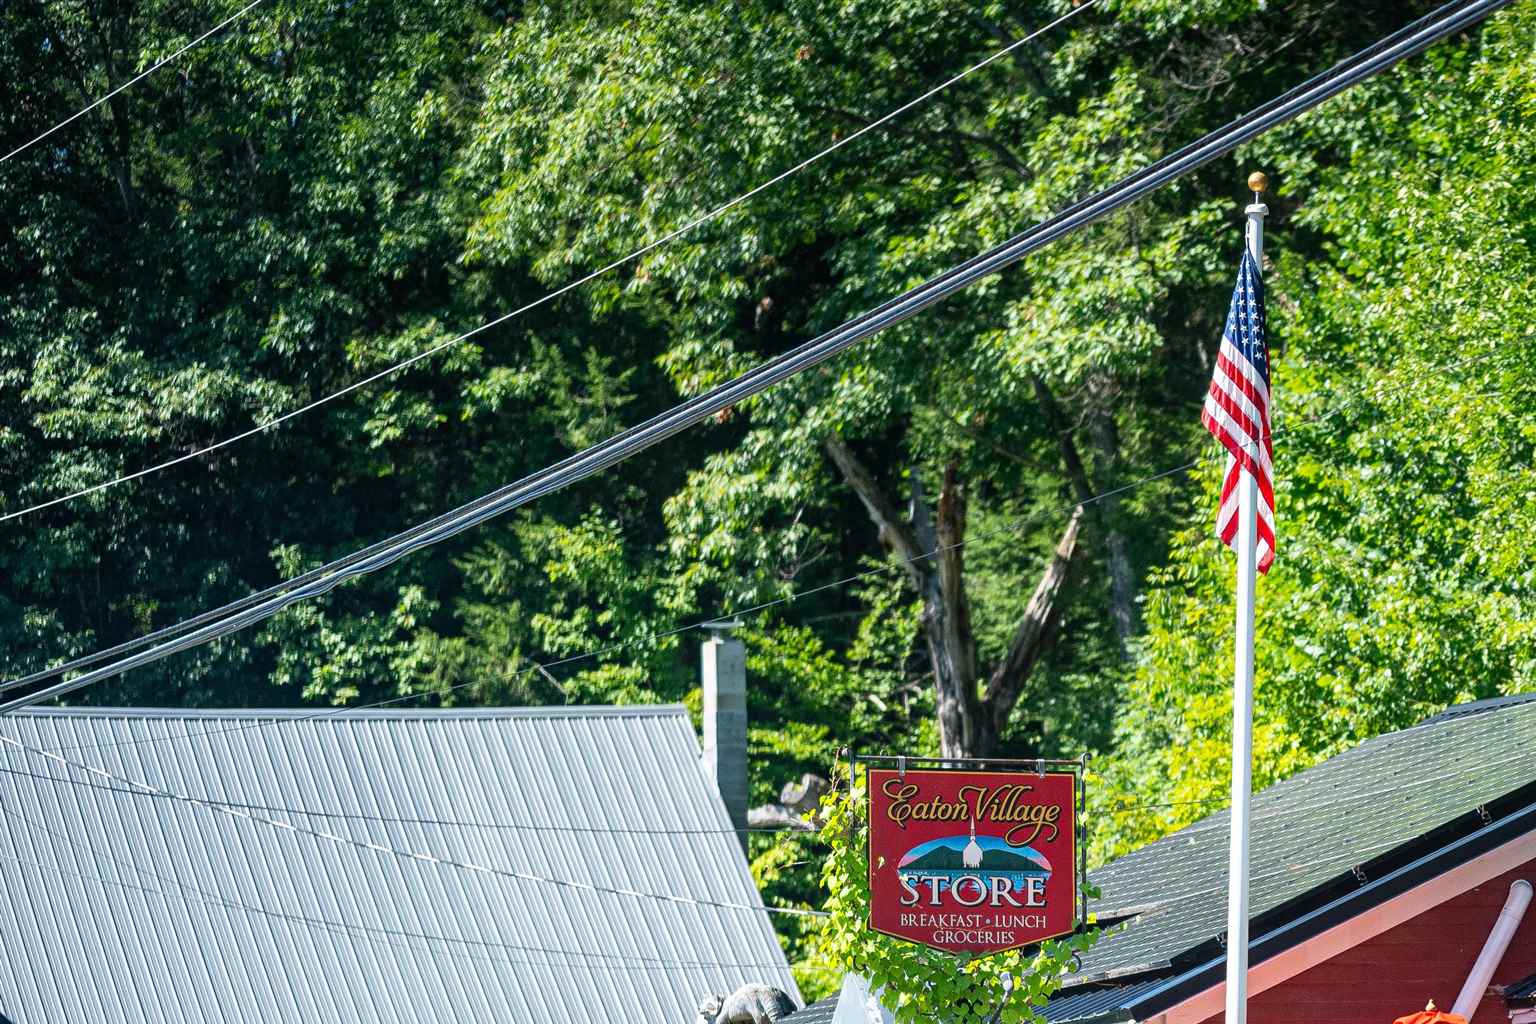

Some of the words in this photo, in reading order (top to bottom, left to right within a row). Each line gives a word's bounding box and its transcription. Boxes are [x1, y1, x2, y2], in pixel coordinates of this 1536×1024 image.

[882, 779, 970, 828] Eaton
[959, 784, 1061, 846] Village
[900, 875, 1046, 908] STORE
[900, 914, 982, 928] BREAKFAST
[995, 915, 1046, 929] LUNCH
[933, 930, 1015, 944] GROCERIES
